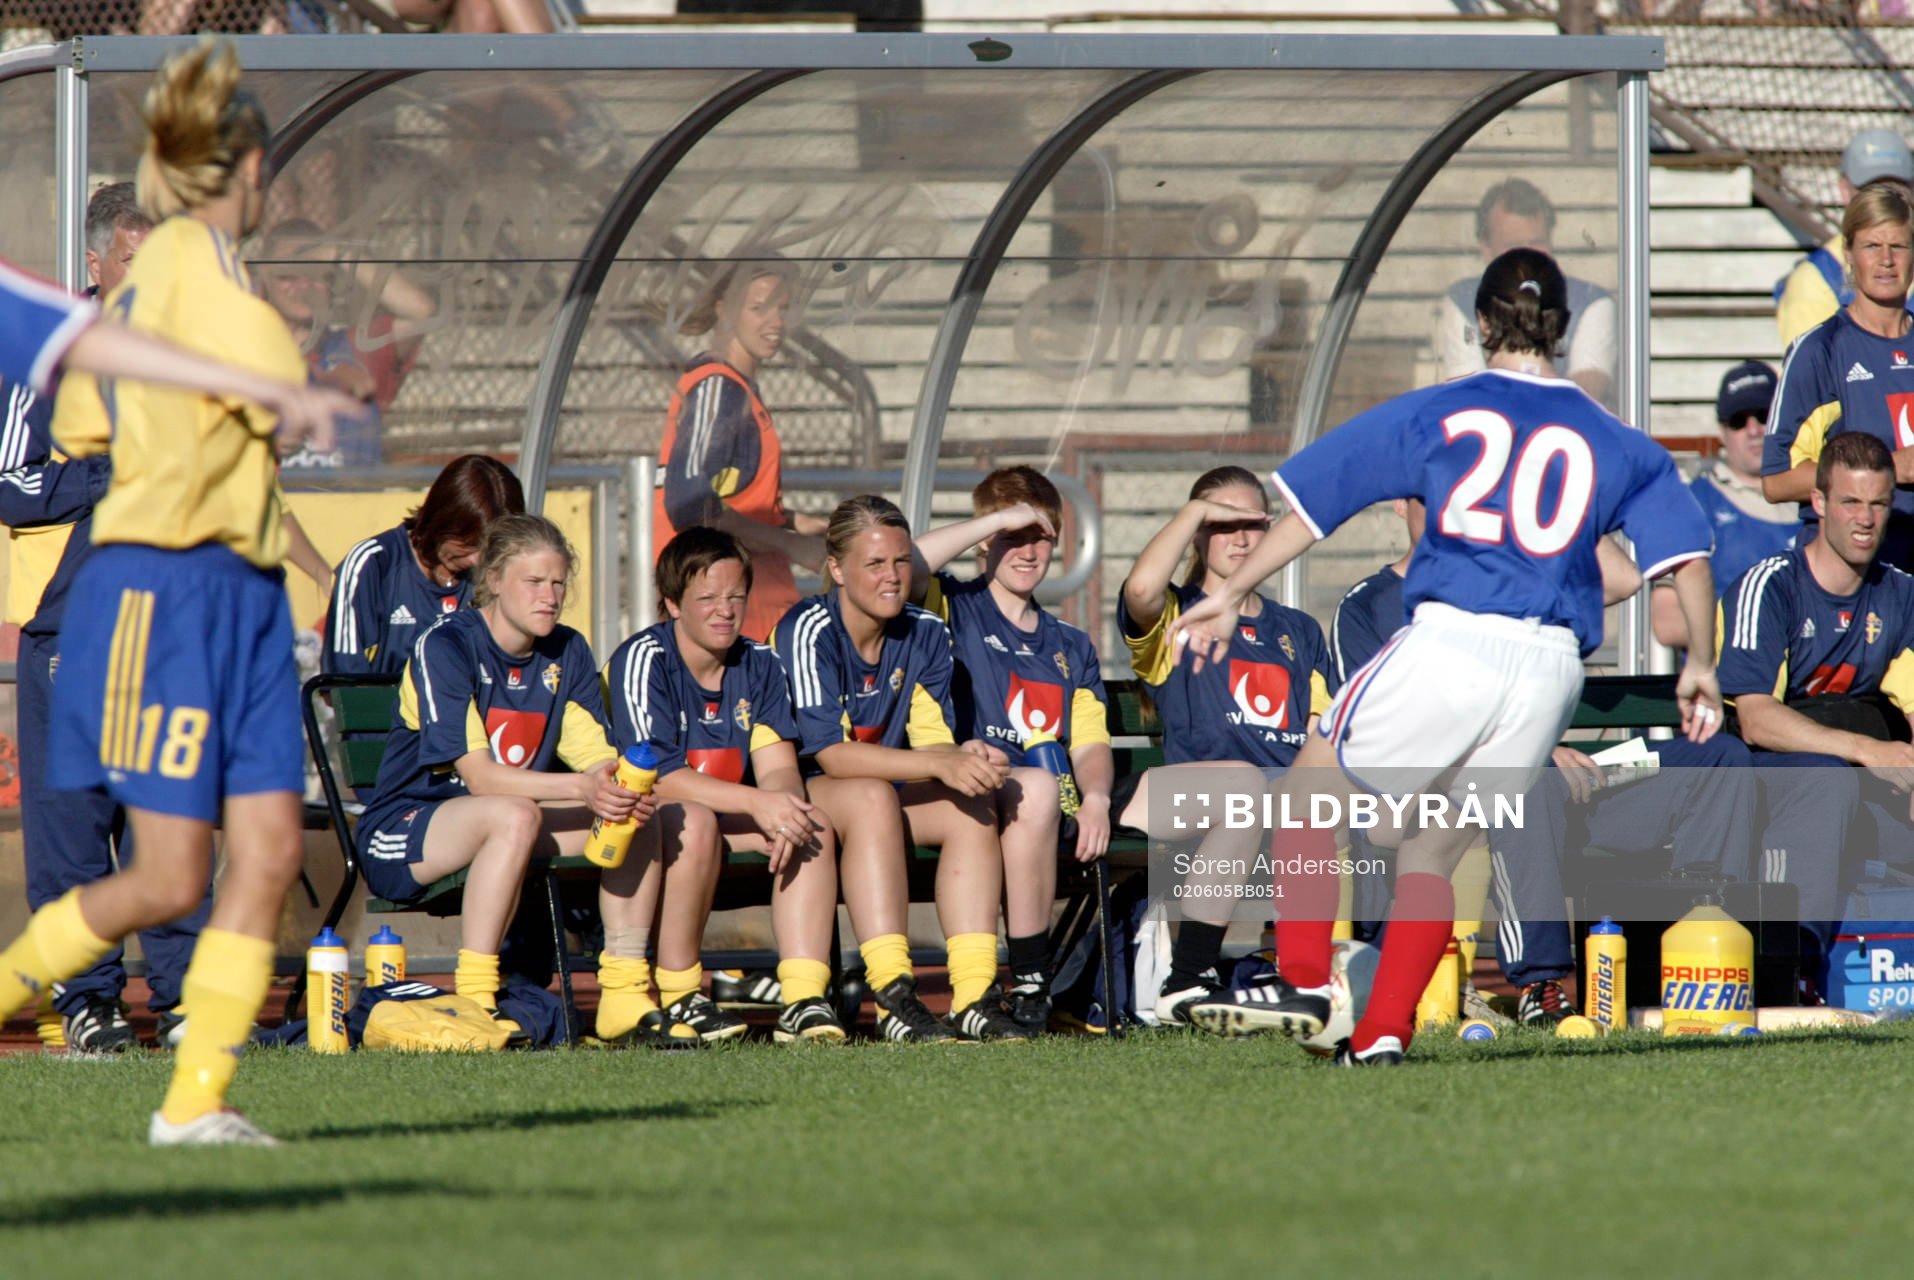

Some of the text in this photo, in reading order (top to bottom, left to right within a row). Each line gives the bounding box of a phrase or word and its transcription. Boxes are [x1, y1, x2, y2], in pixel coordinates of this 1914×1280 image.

[1438, 407, 1597, 557] 20
[137, 703, 211, 780] 18
[331, 971, 345, 1037] NERGY
[1591, 972, 1599, 1017] RIPPS
[1598, 952, 1613, 1024] ENERGY
[1662, 966, 1750, 983] PRIPPS
[1867, 986, 1914, 1008] SPO
